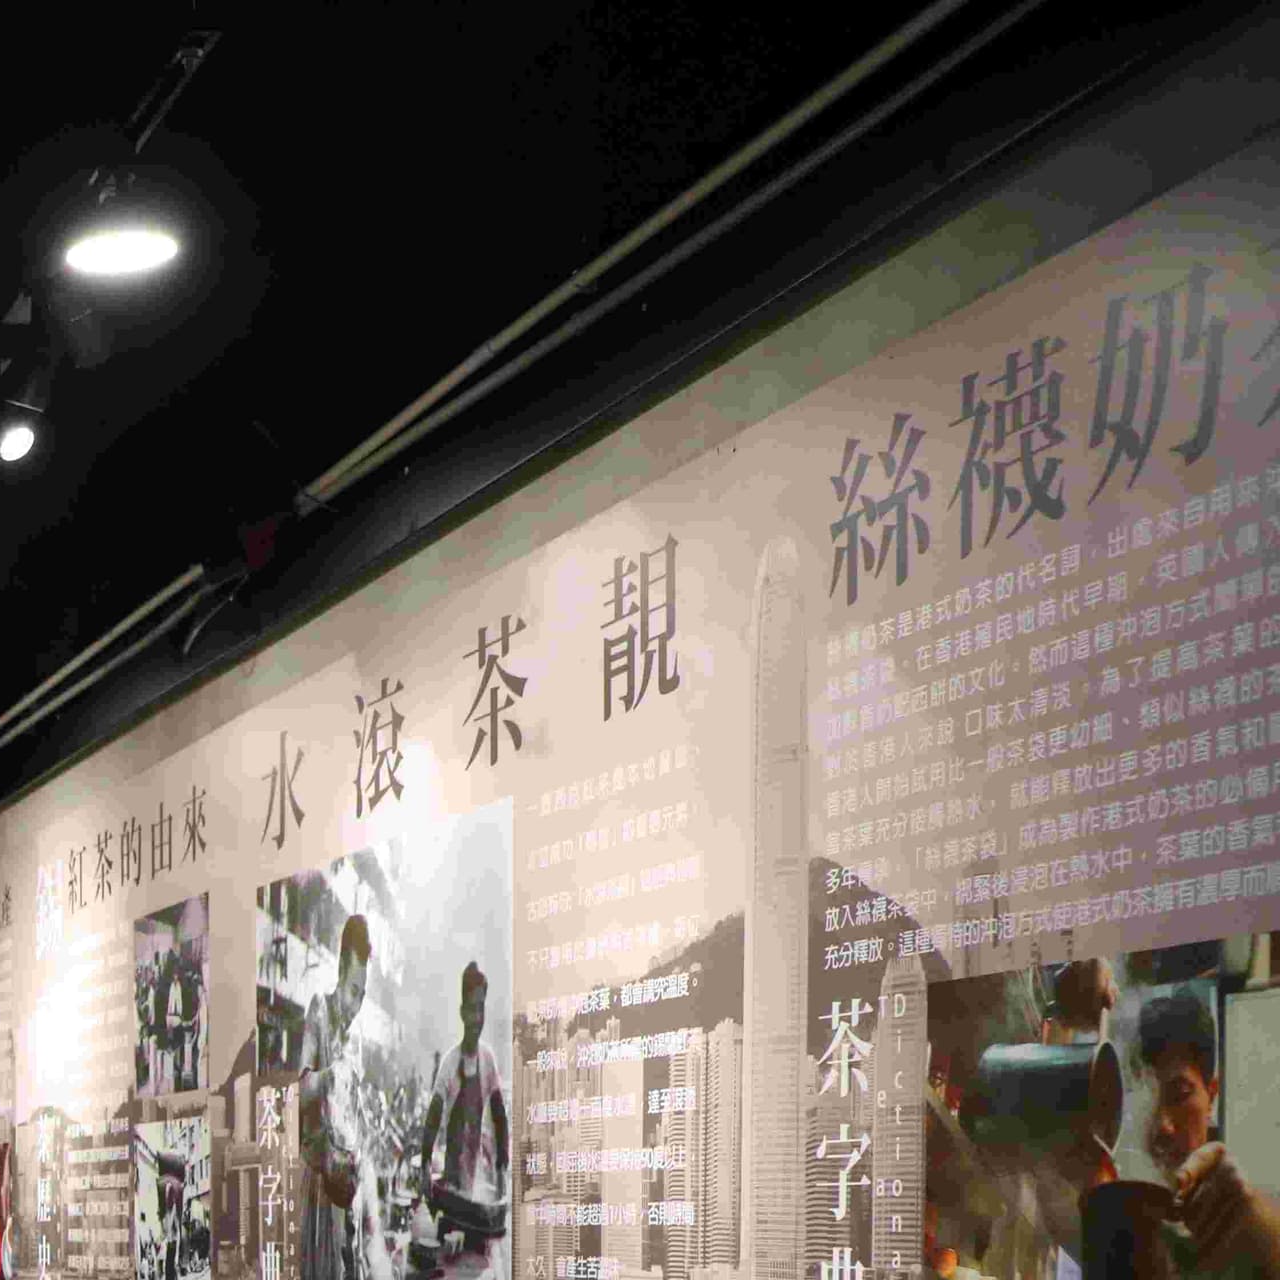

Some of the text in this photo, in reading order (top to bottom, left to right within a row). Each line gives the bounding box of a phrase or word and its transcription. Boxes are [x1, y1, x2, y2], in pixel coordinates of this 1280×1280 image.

[261, 533, 681, 851] 水滾茶靚
[68, 784, 207, 915] 紅茶的由來
